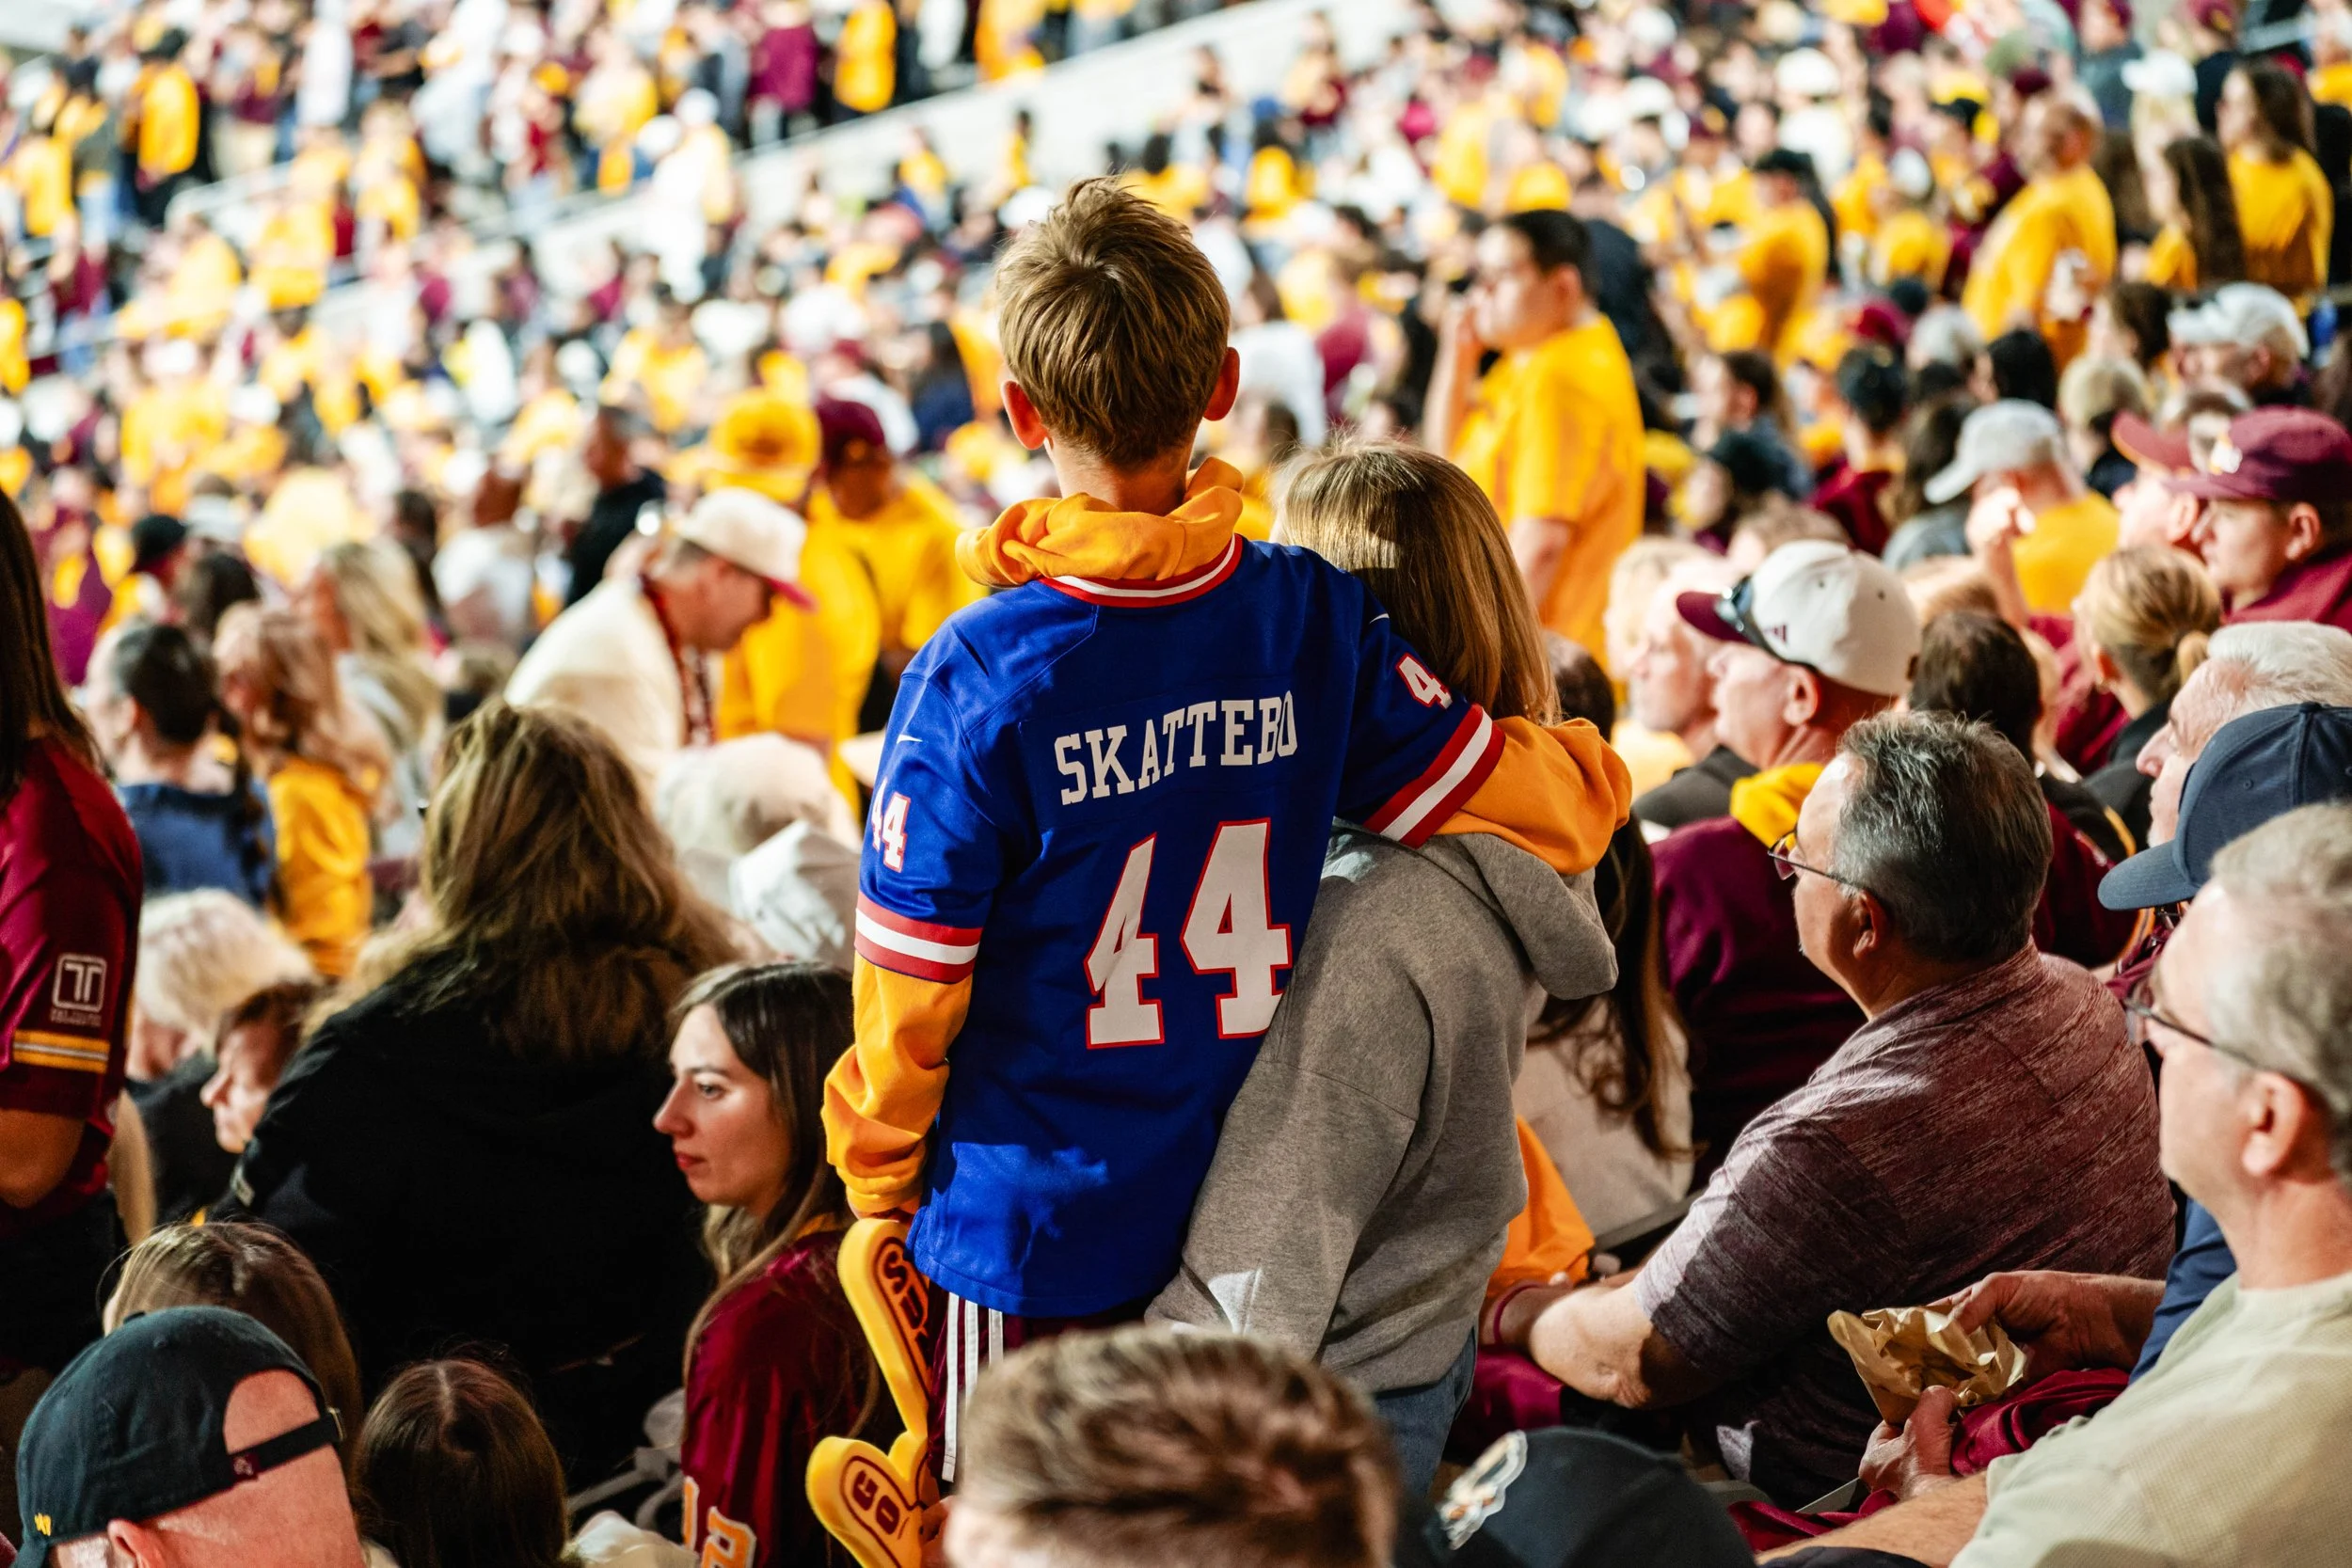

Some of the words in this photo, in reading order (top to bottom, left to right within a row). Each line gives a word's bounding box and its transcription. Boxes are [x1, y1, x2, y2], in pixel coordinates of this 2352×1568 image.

[1054, 690, 1297, 805] SKATTEBO
[871, 776, 911, 873] 44
[1084, 817, 1293, 1050] 44
[852, 1470, 900, 1535] GO
